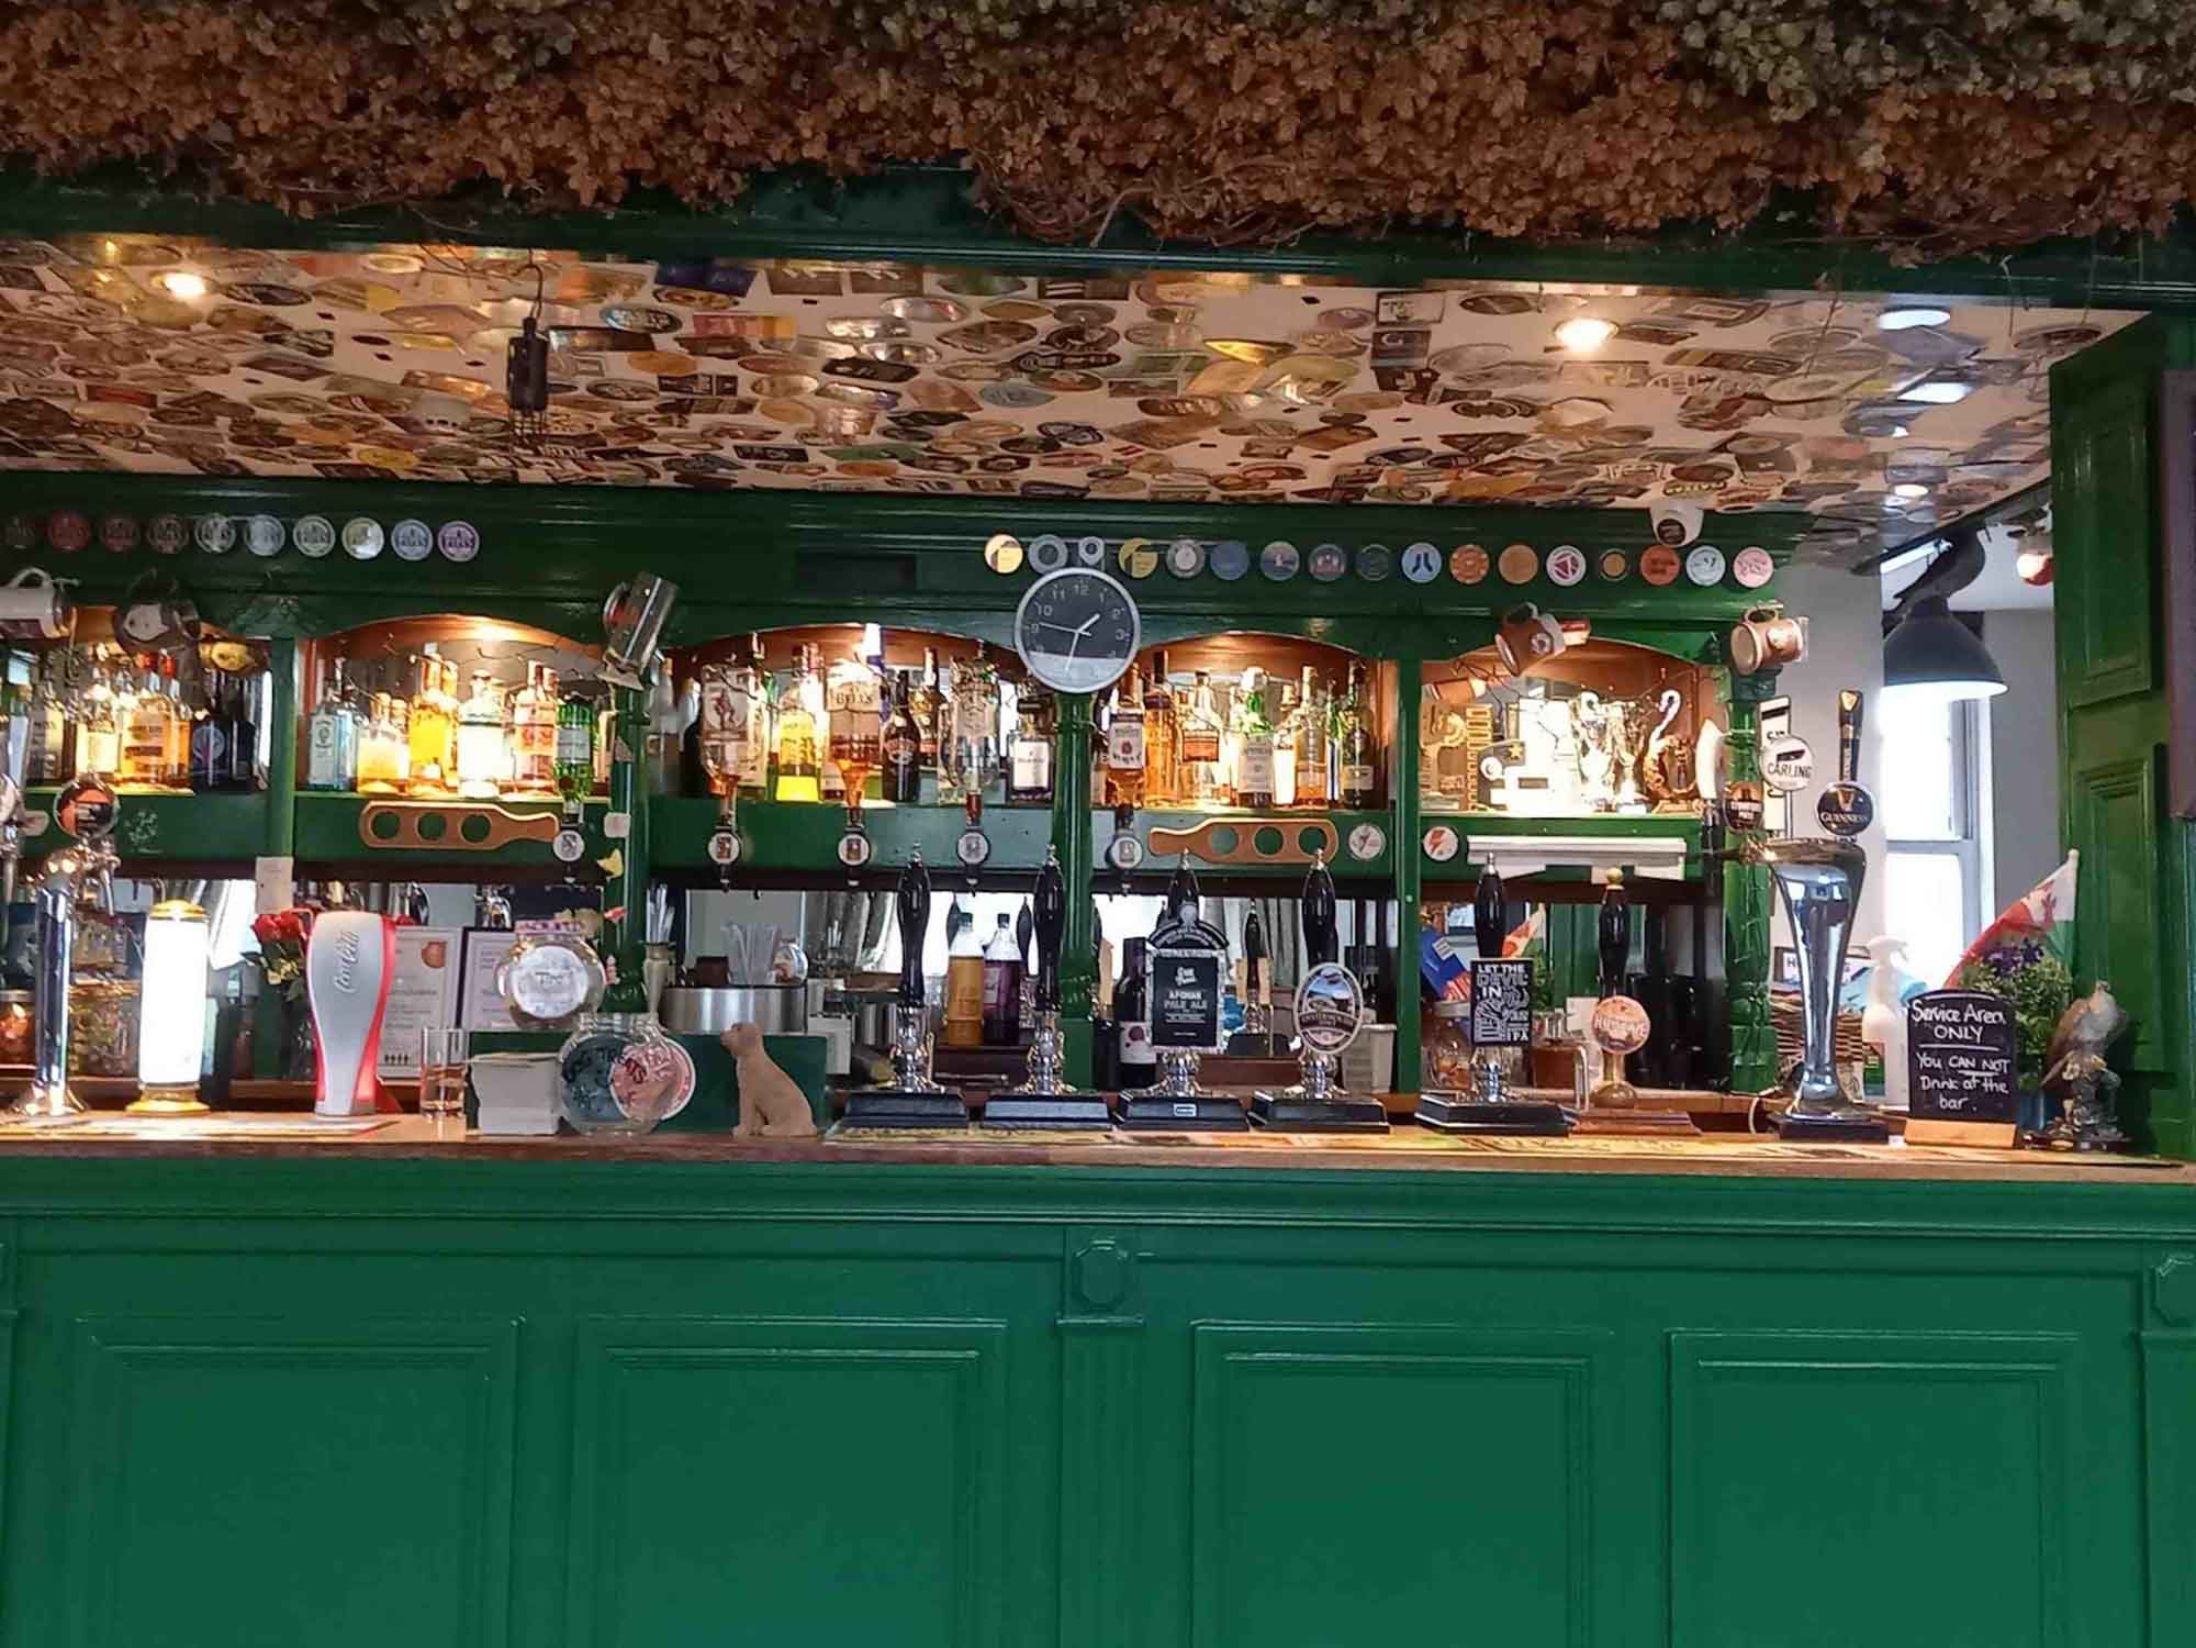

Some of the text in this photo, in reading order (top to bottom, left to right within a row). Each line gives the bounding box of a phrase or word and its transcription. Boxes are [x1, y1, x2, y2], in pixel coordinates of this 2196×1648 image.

[1052, 590, 1065, 601] 11
[1074, 584, 1089, 596] 12
[1038, 603, 1053, 616] 10
[1767, 761, 1813, 779] CARLING
[1820, 811, 1868, 824] GUINNESS
[1478, 964, 1525, 974] LET THE
[1482, 986, 1502, 999] IN
[1163, 1000, 1208, 1010] PALE ALE
[1911, 1000, 2007, 1024] Service Area
[1933, 1024, 1983, 1044] ONLY
[1916, 1052, 2011, 1073] You CAN NOT
[1962, 1074, 1980, 1090] at
[1982, 1077, 2009, 1094] the
